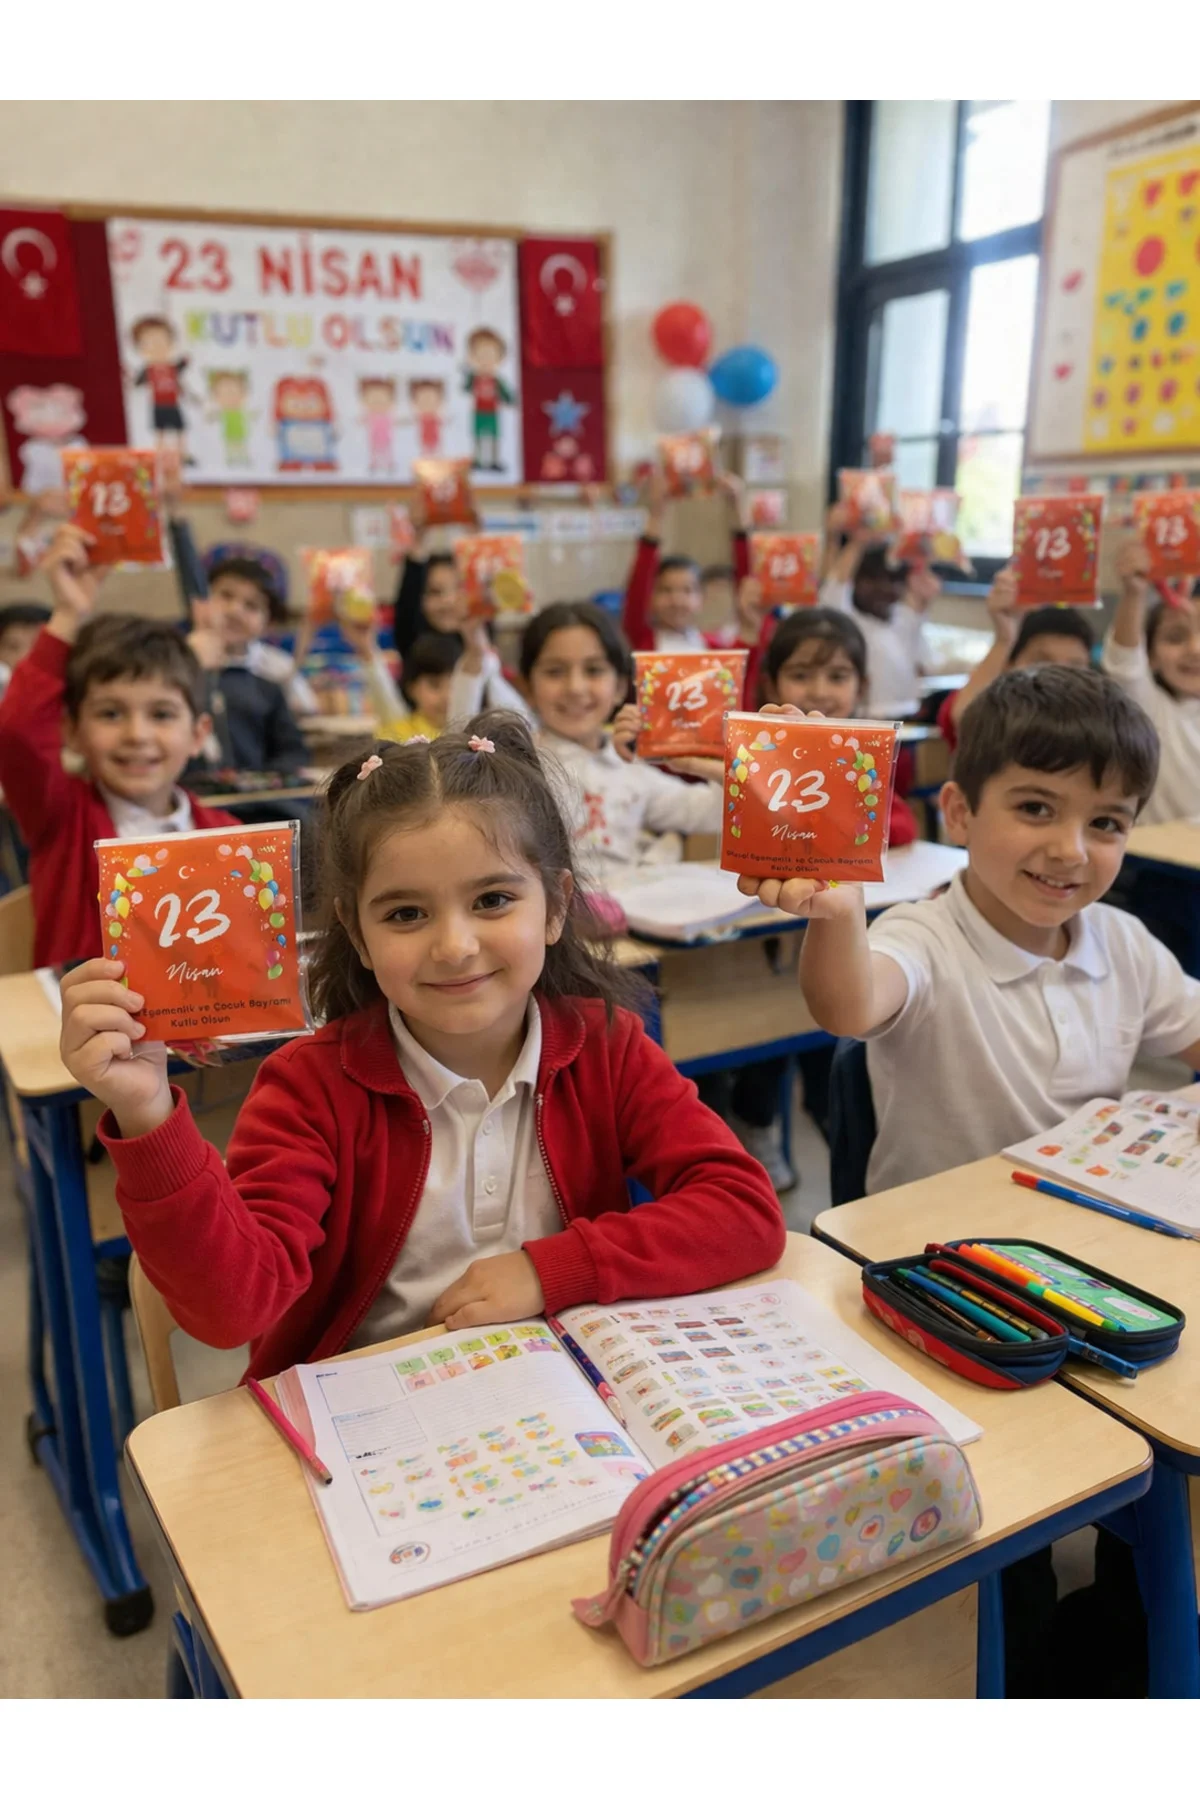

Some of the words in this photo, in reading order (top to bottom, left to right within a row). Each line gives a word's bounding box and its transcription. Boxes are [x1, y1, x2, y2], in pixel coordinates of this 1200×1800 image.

[159, 238, 232, 292] 23
[185, 311, 313, 348] KUTLU
[322, 313, 456, 353] OLSUN
[665, 680, 708, 711] 23
[767, 768, 830, 813] 23
[771, 824, 818, 841] Nisan
[154, 889, 231, 947] 23
[165, 961, 224, 984] Nisan
[198, 1004, 210, 1012] ve
[201, 1015, 231, 1025] Olsun
